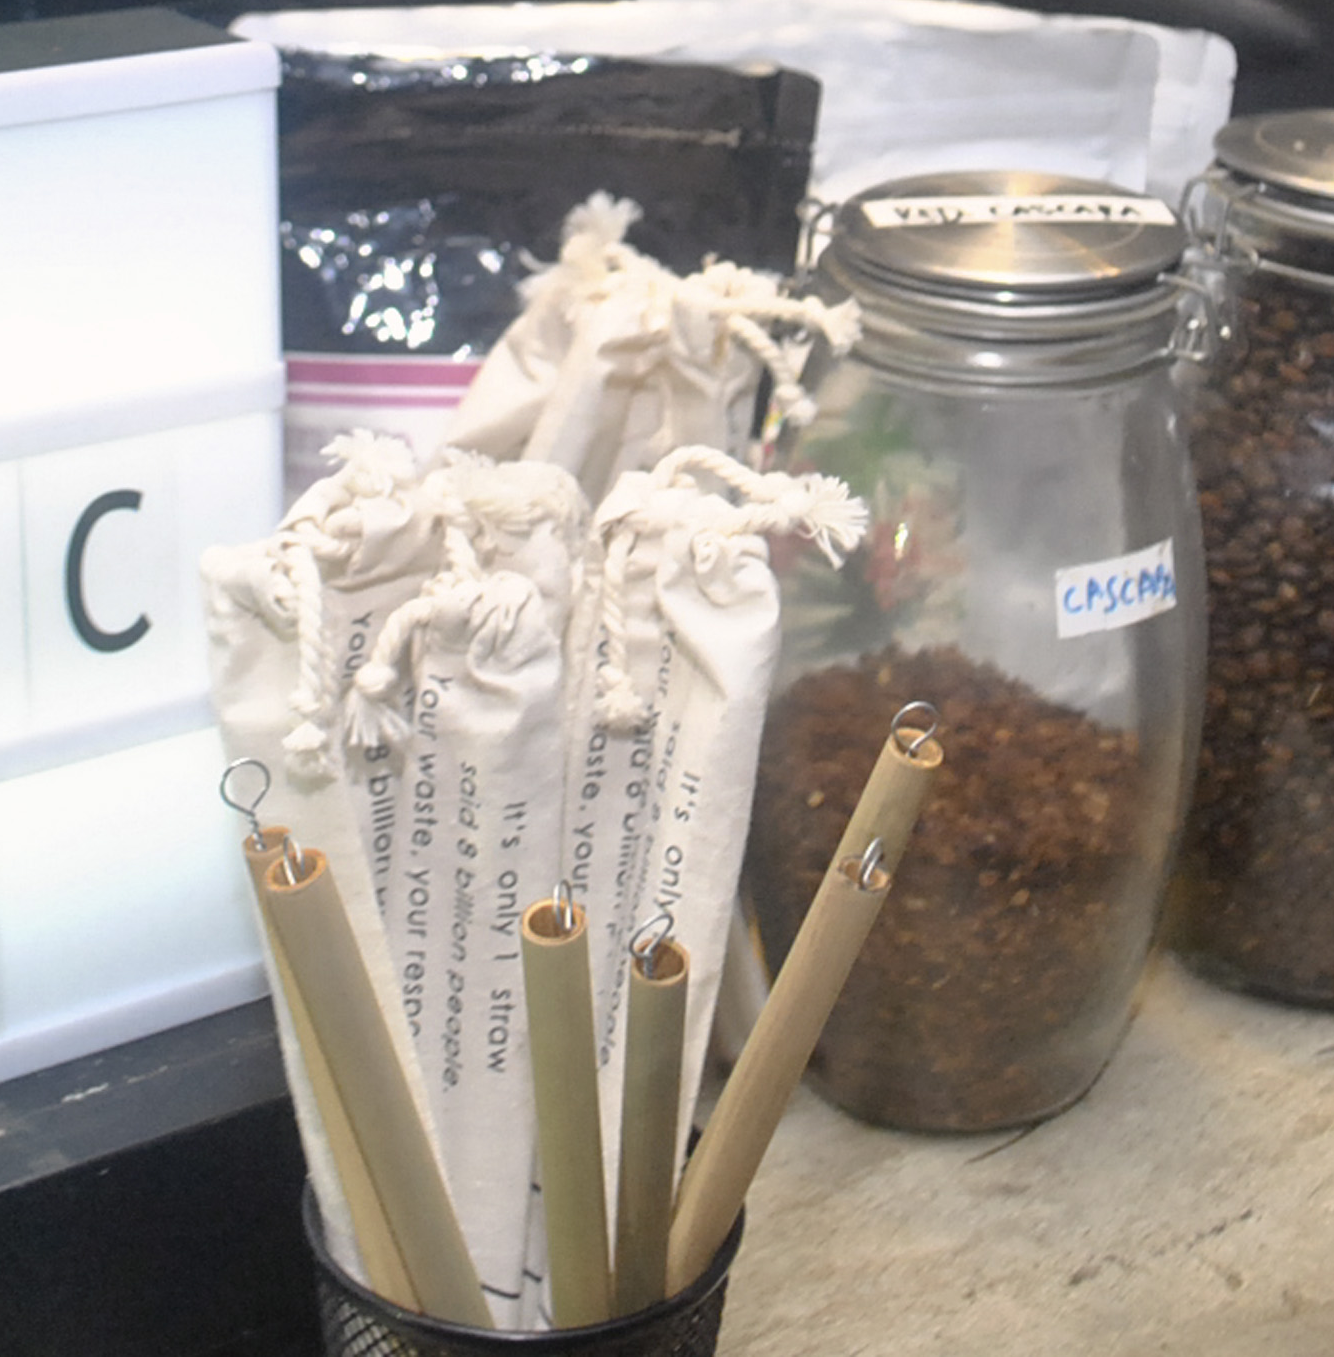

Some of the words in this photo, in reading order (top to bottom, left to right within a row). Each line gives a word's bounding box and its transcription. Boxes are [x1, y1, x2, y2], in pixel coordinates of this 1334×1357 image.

[418, 674, 454, 741] Your
[457, 761, 481, 831] said
[500, 800, 528, 850] It's
[674, 770, 701, 823] It's
[573, 822, 595, 893] your
[654, 845, 683, 914] only
[404, 869, 430, 937] your
[451, 867, 475, 963] billion
[489, 869, 521, 937] only
[486, 988, 517, 1074] straw
